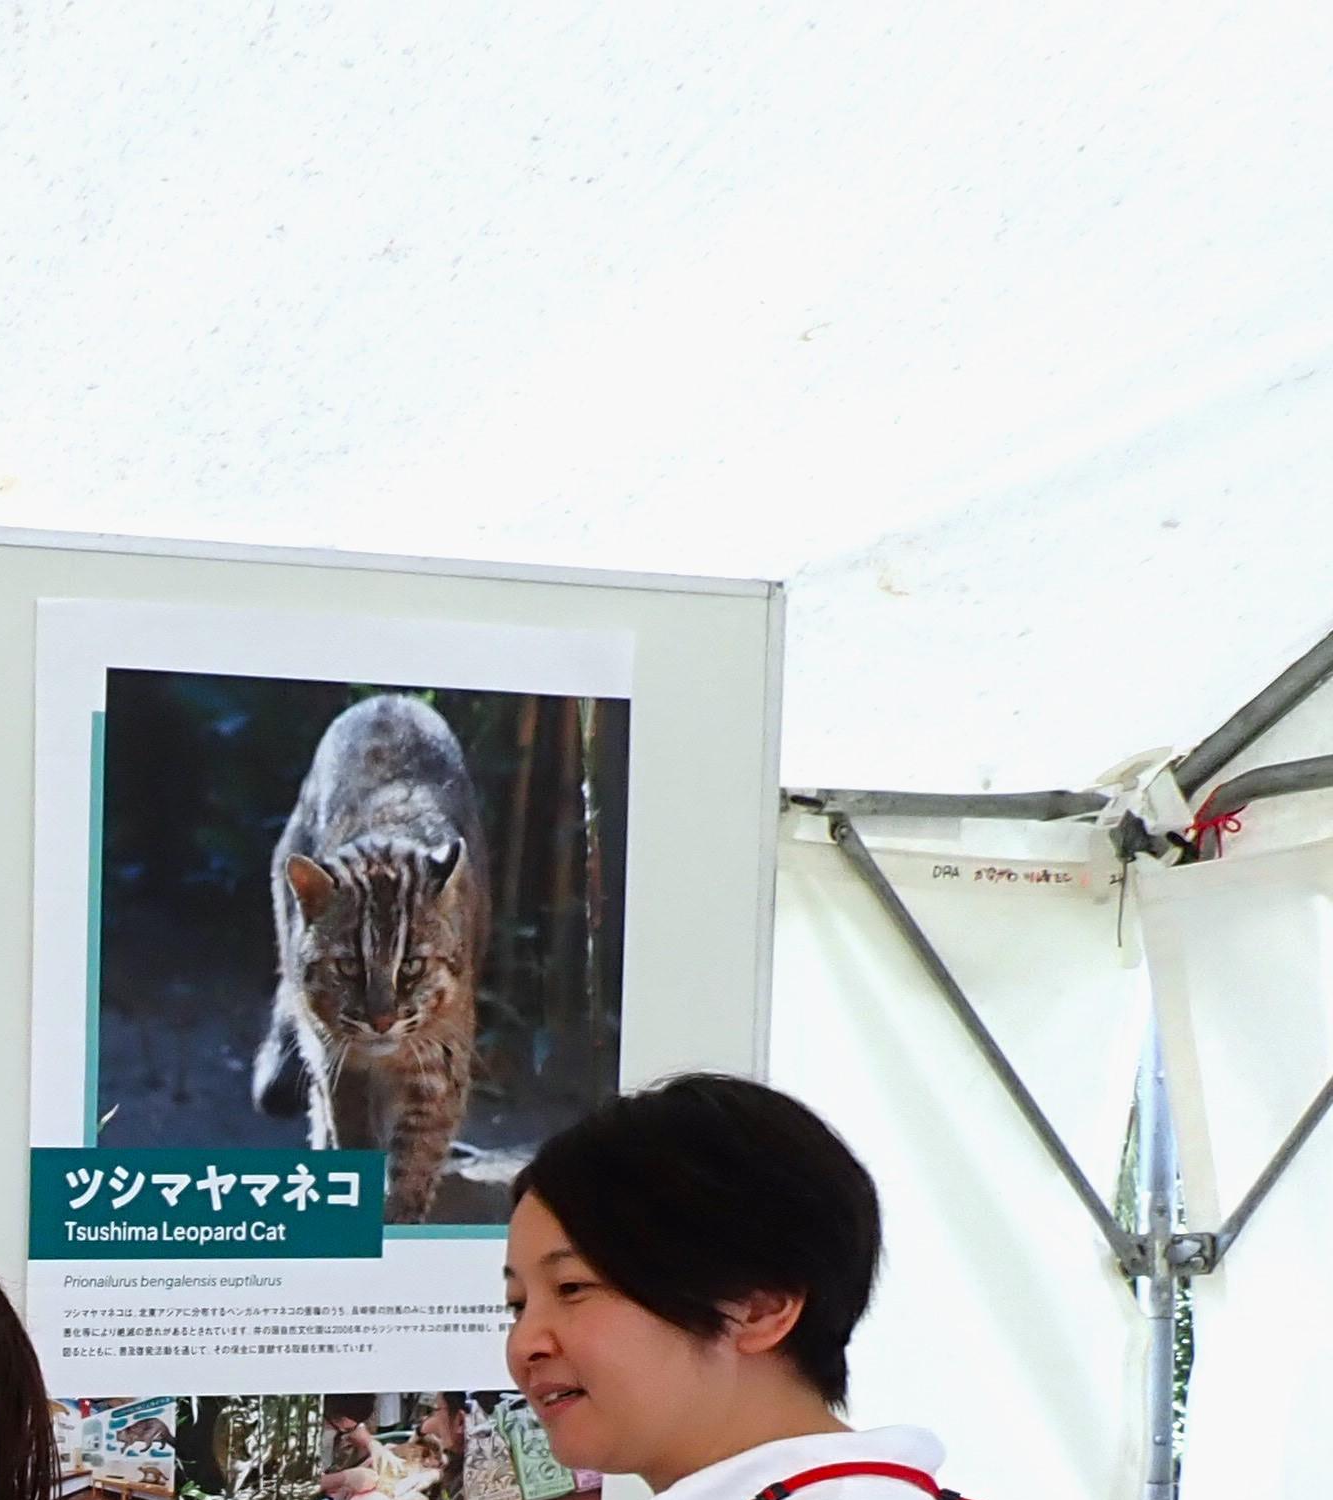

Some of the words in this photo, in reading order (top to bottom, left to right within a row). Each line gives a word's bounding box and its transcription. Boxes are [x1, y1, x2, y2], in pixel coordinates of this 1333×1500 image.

[64, 1164, 360, 1213] ツシマヤマネコ
[64, 1220, 159, 1242] Tsushima
[162, 1220, 248, 1246] Leopard
[250, 1221, 287, 1242] Cat
[63, 1275, 138, 1288] Prionailurus
[140, 1274, 217, 1290] bengalensis
[219, 1275, 283, 1290] euptilurus
